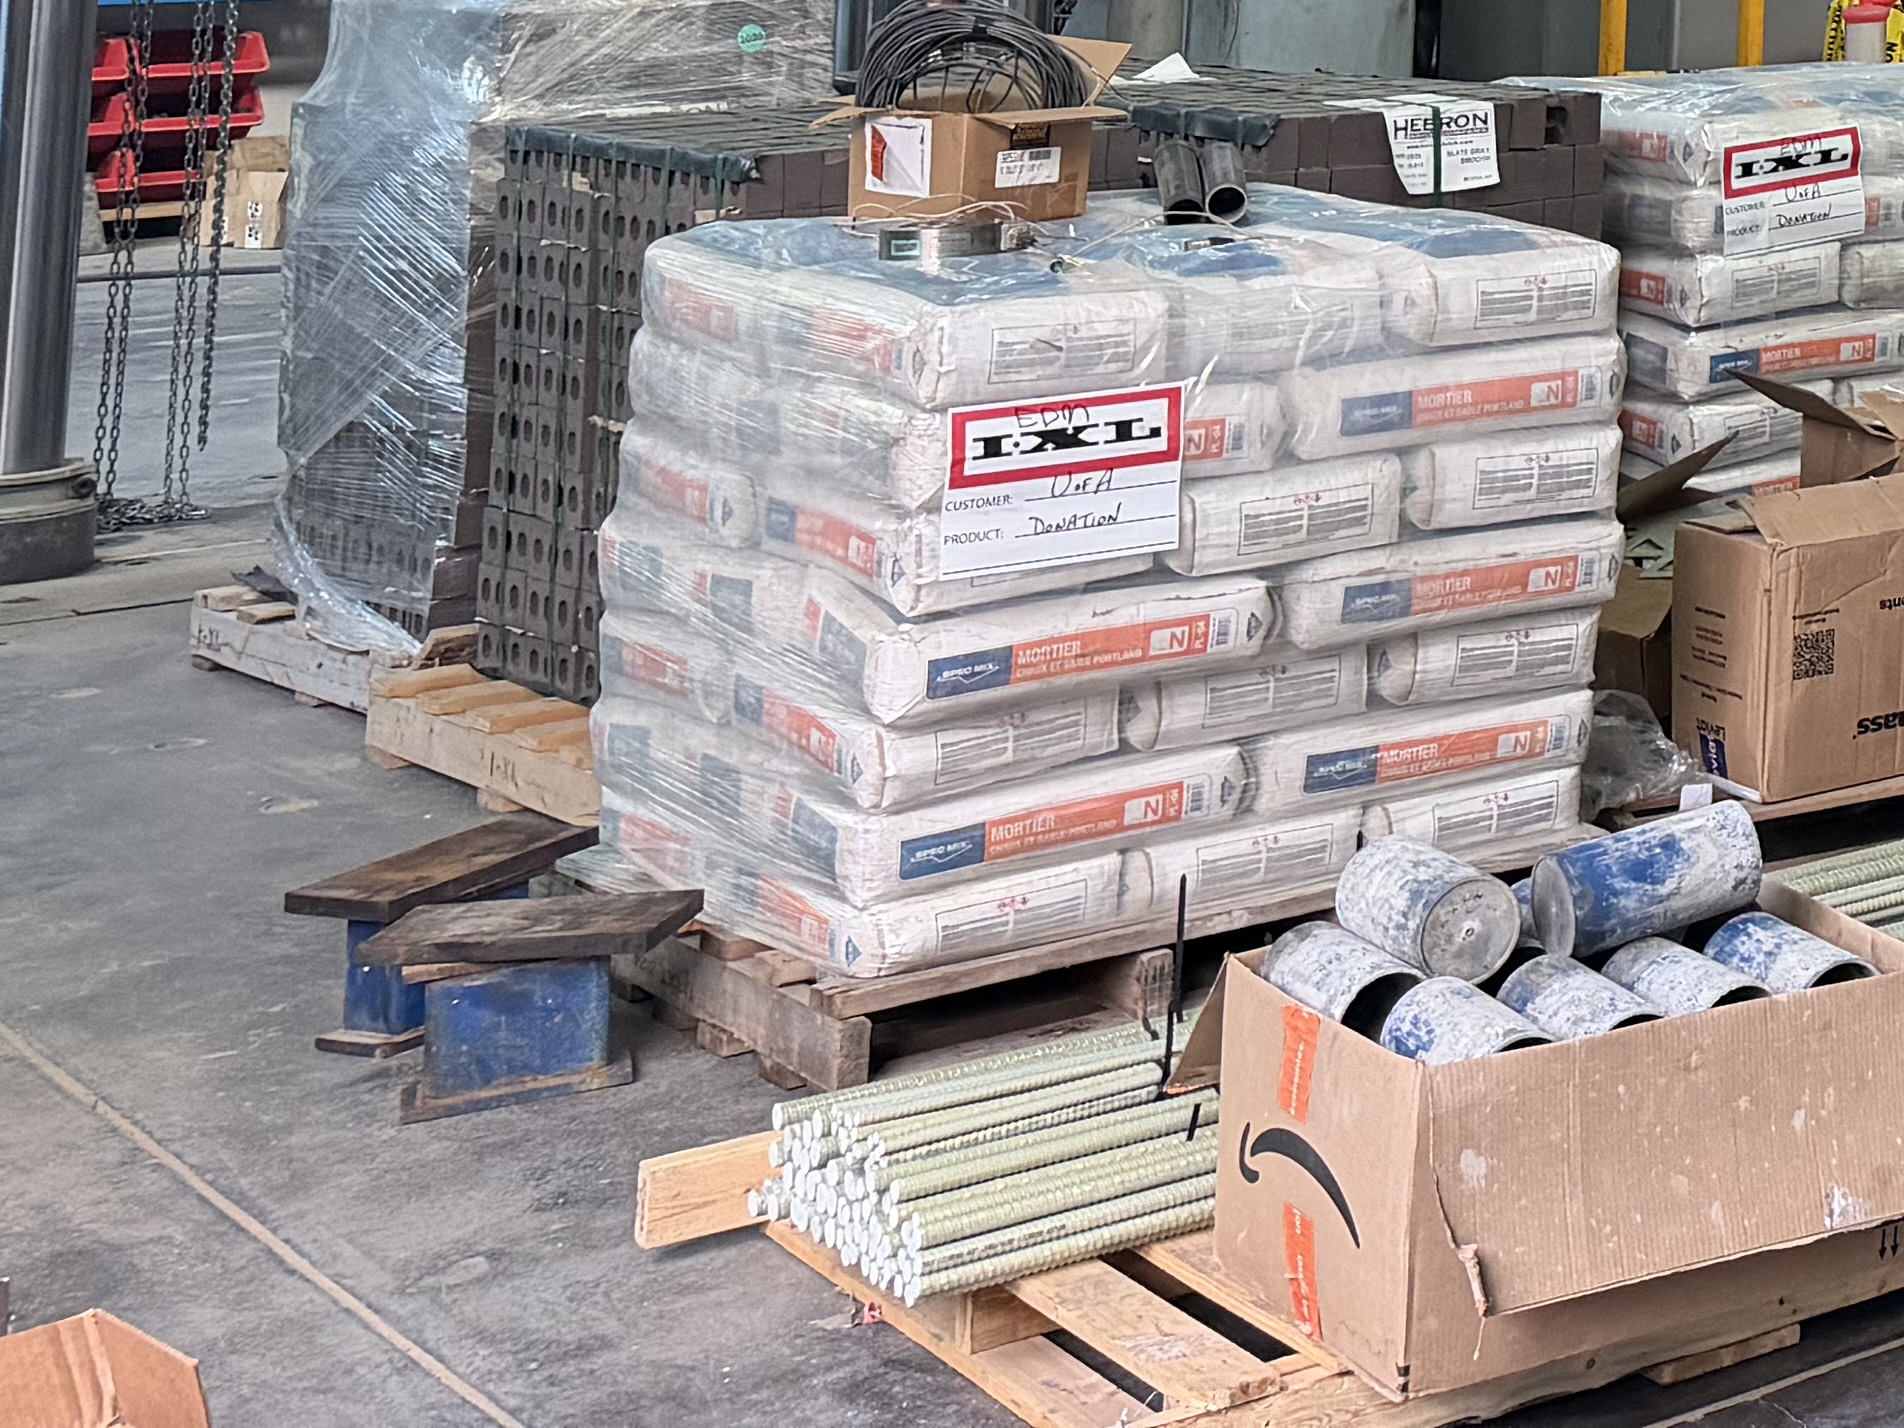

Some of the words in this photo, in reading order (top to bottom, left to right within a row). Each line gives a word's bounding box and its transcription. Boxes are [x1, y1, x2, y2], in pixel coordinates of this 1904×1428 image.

[1417, 389, 1473, 410] MORTIER
[1545, 383, 1562, 403] N
[944, 495, 1014, 512] CUSTOMER:
[943, 528, 1005, 545] PRODUCT:
[1416, 575, 1472, 598] MORTIER
[1544, 567, 1560, 588] N
[1016, 640, 1082, 665] MORTIER
[1168, 629, 1186, 649] N
[1092, 648, 1143, 667] PORTLAND
[1513, 732, 1530, 754] N
[990, 815, 1056, 842] MORTIER
[1143, 798, 1161, 820] N
